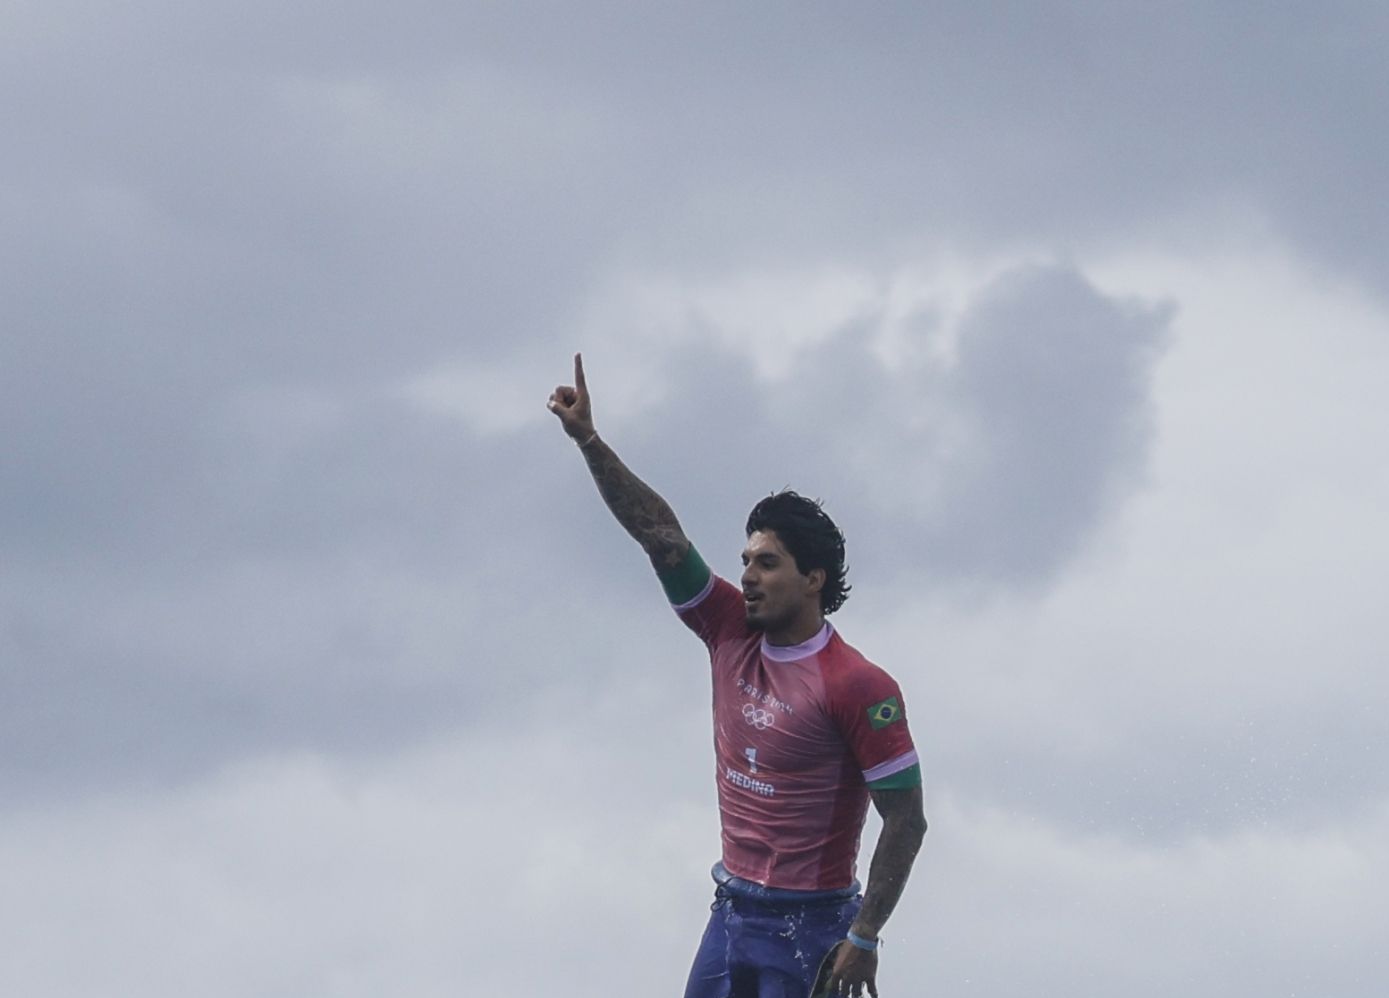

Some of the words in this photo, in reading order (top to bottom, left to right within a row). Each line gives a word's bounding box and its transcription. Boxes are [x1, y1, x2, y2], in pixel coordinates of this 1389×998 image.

[736, 678, 770, 704] PARIS
[744, 747, 758, 774] 1
[726, 767, 775, 796] MEDINA
